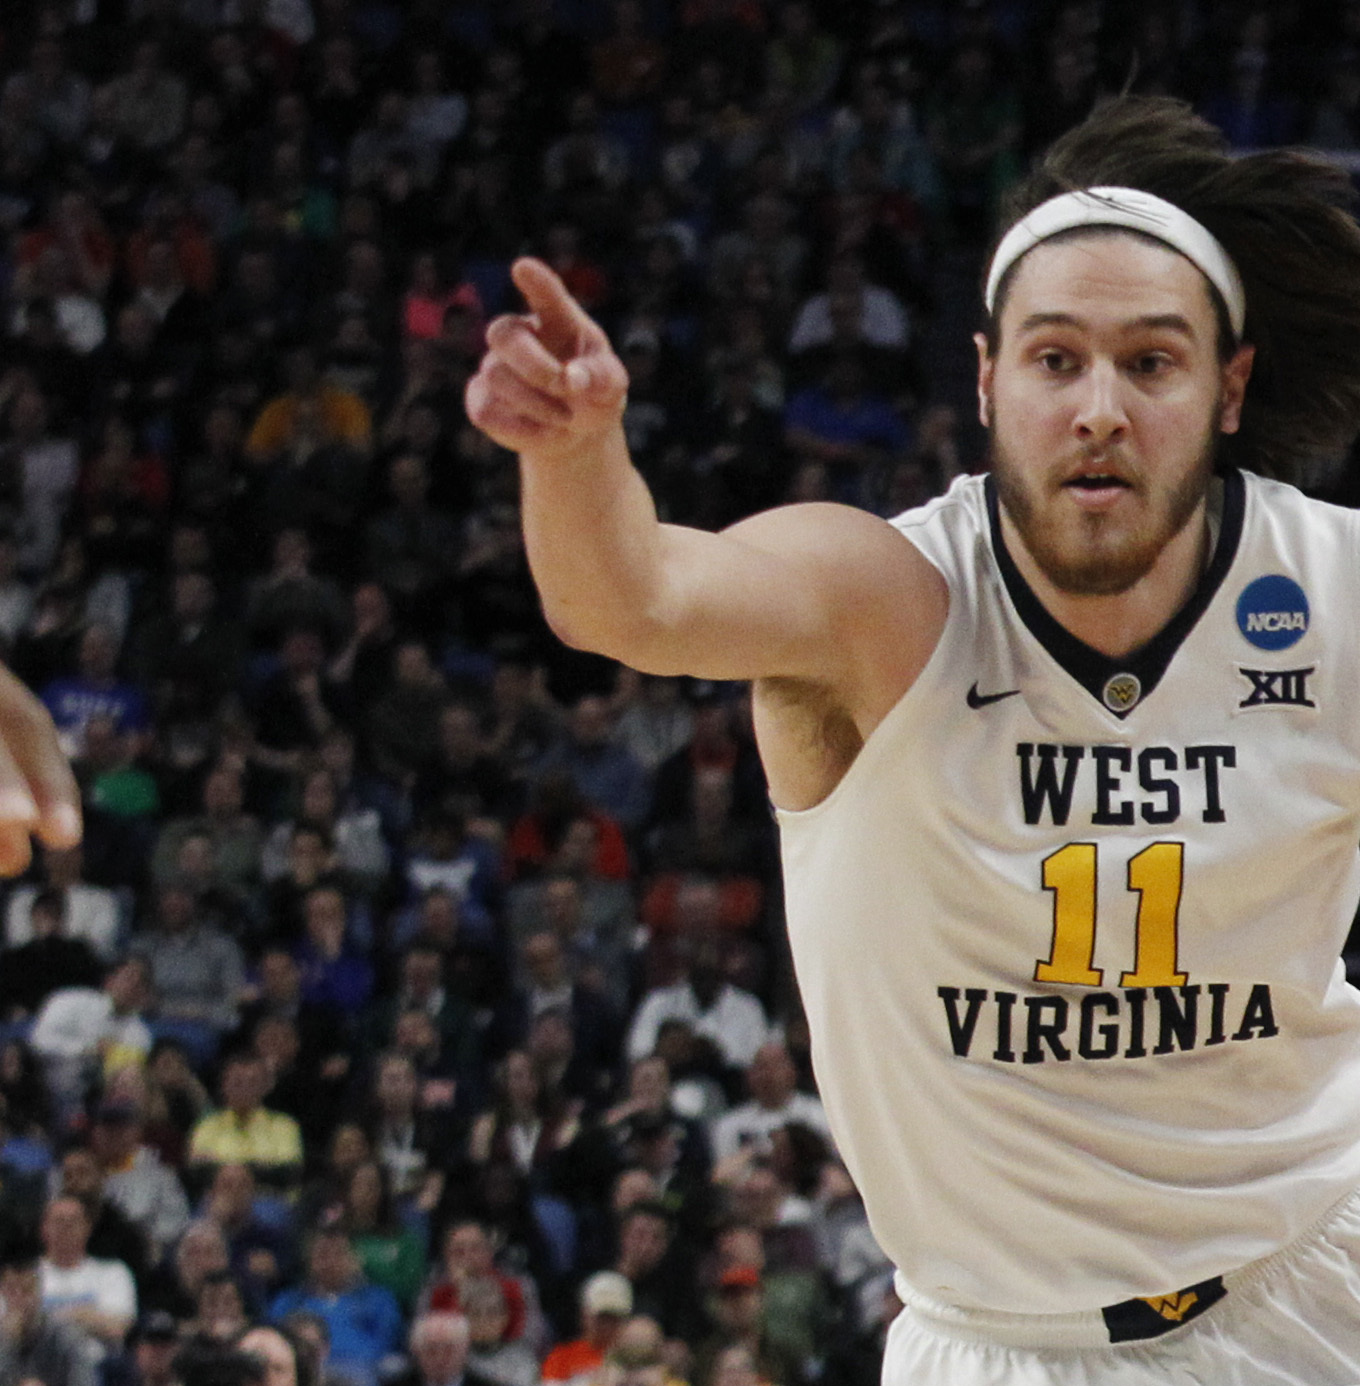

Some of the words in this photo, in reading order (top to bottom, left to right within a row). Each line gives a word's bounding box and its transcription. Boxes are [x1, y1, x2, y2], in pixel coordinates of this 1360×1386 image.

[1246, 611, 1308, 633] NCAA
[1016, 742, 1237, 826] WEST
[1033, 841, 1190, 988] 11
[937, 983, 1280, 1064] VIRGINIA
